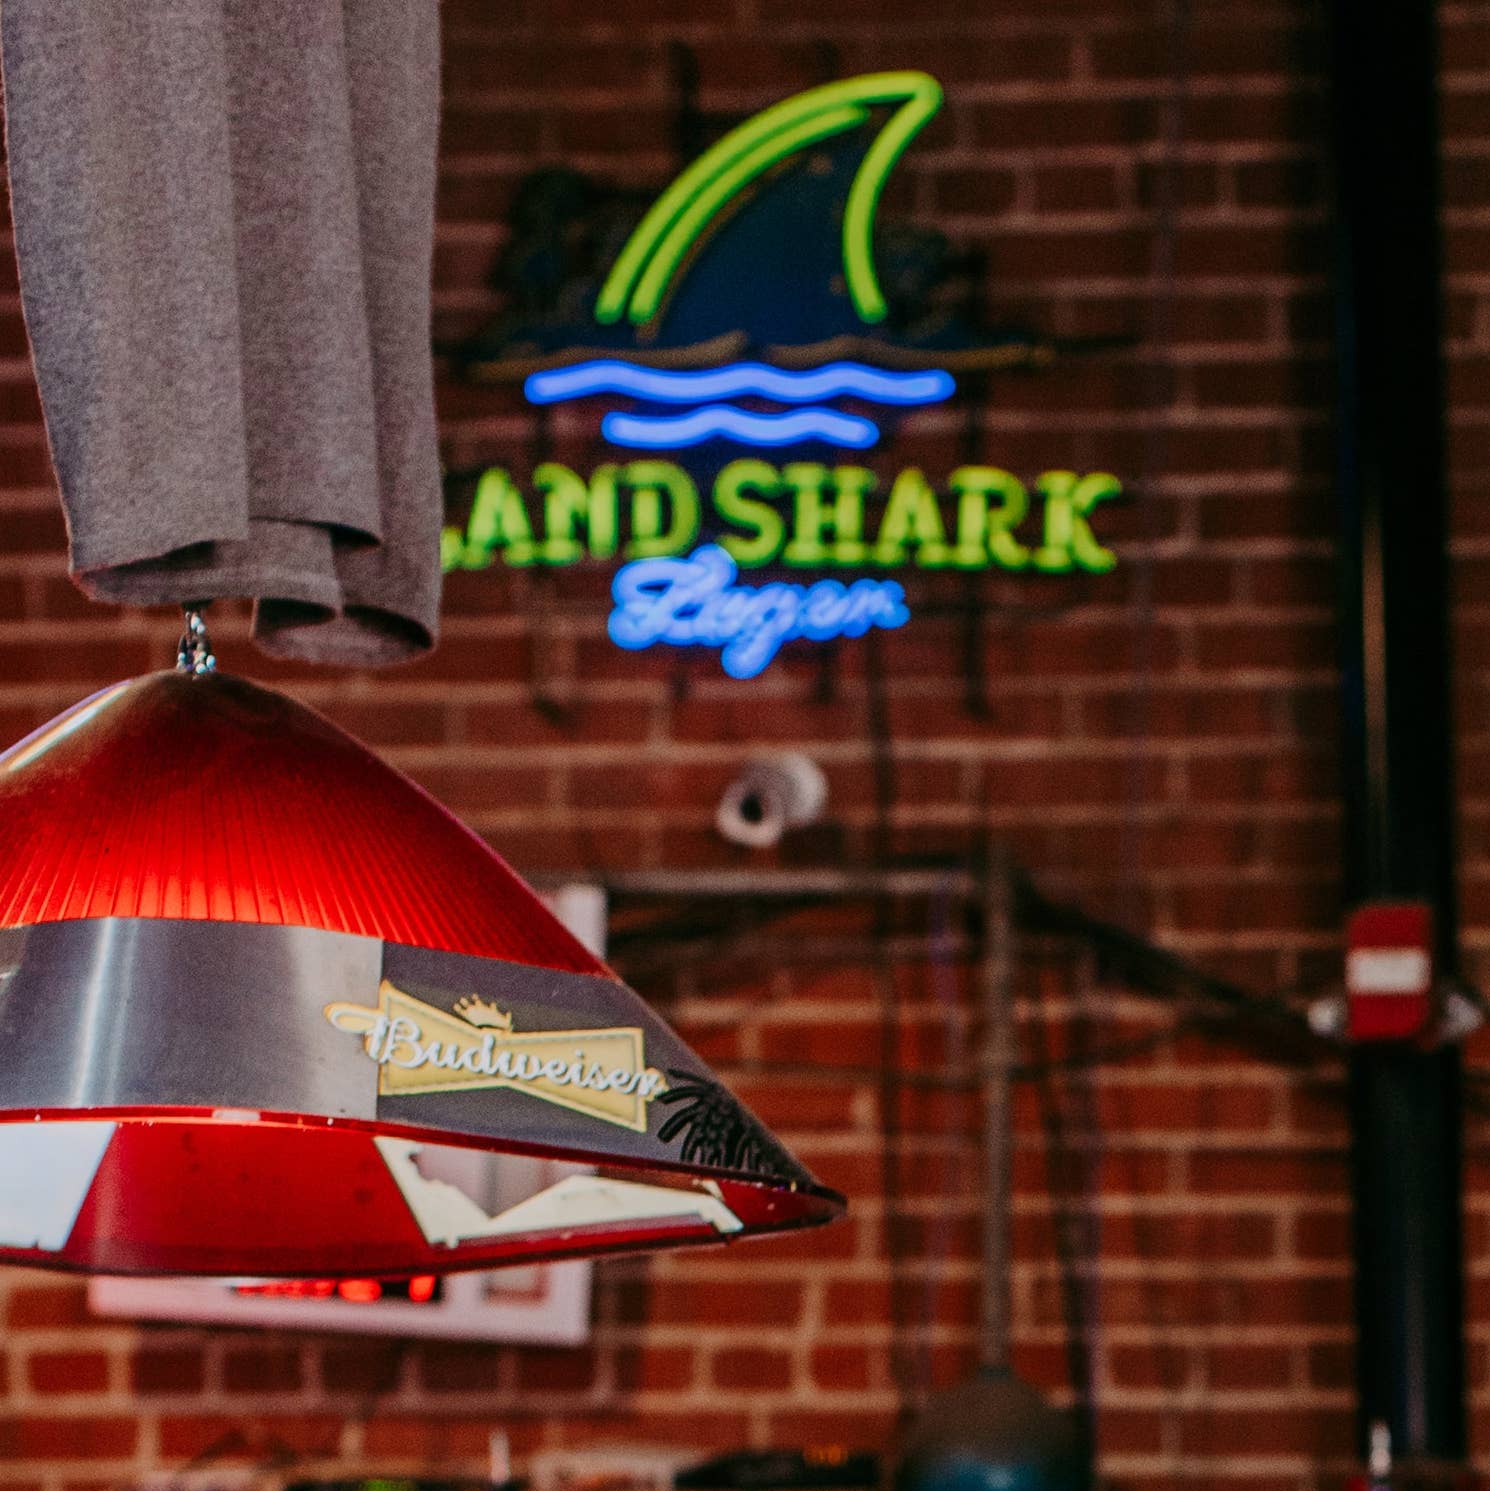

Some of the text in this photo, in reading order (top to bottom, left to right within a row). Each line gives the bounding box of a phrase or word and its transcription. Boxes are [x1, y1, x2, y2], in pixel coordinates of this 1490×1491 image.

[440, 458, 1122, 573] AND SHARK
[329, 1006, 668, 1099] Budweiser
